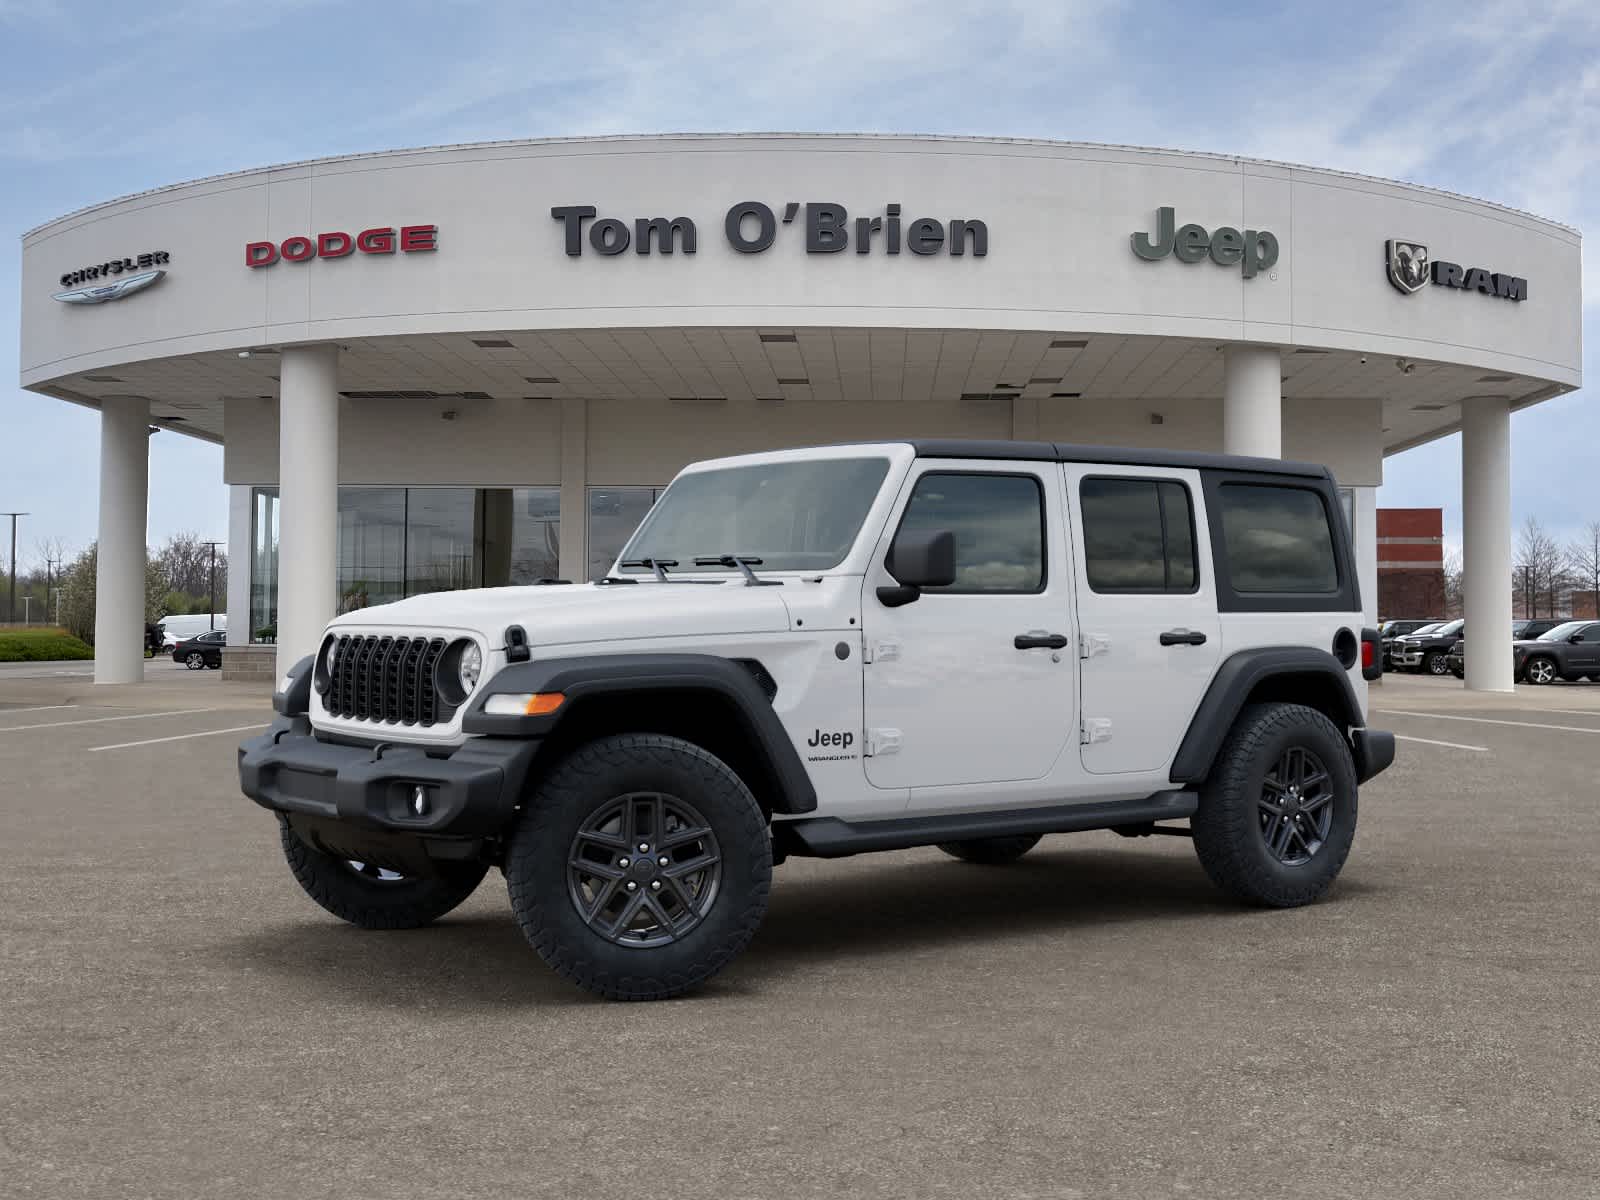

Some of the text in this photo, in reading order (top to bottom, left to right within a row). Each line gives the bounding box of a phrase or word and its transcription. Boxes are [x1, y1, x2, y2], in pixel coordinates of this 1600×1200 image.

[245, 224, 438, 270] DODGE
[551, 200, 988, 257] Tom O'Brien
[1130, 206, 1279, 279] Jeep
[60, 250, 170, 287] CHRYSLER
[1430, 260, 1528, 302] RAM
[807, 728, 853, 749] Jeep
